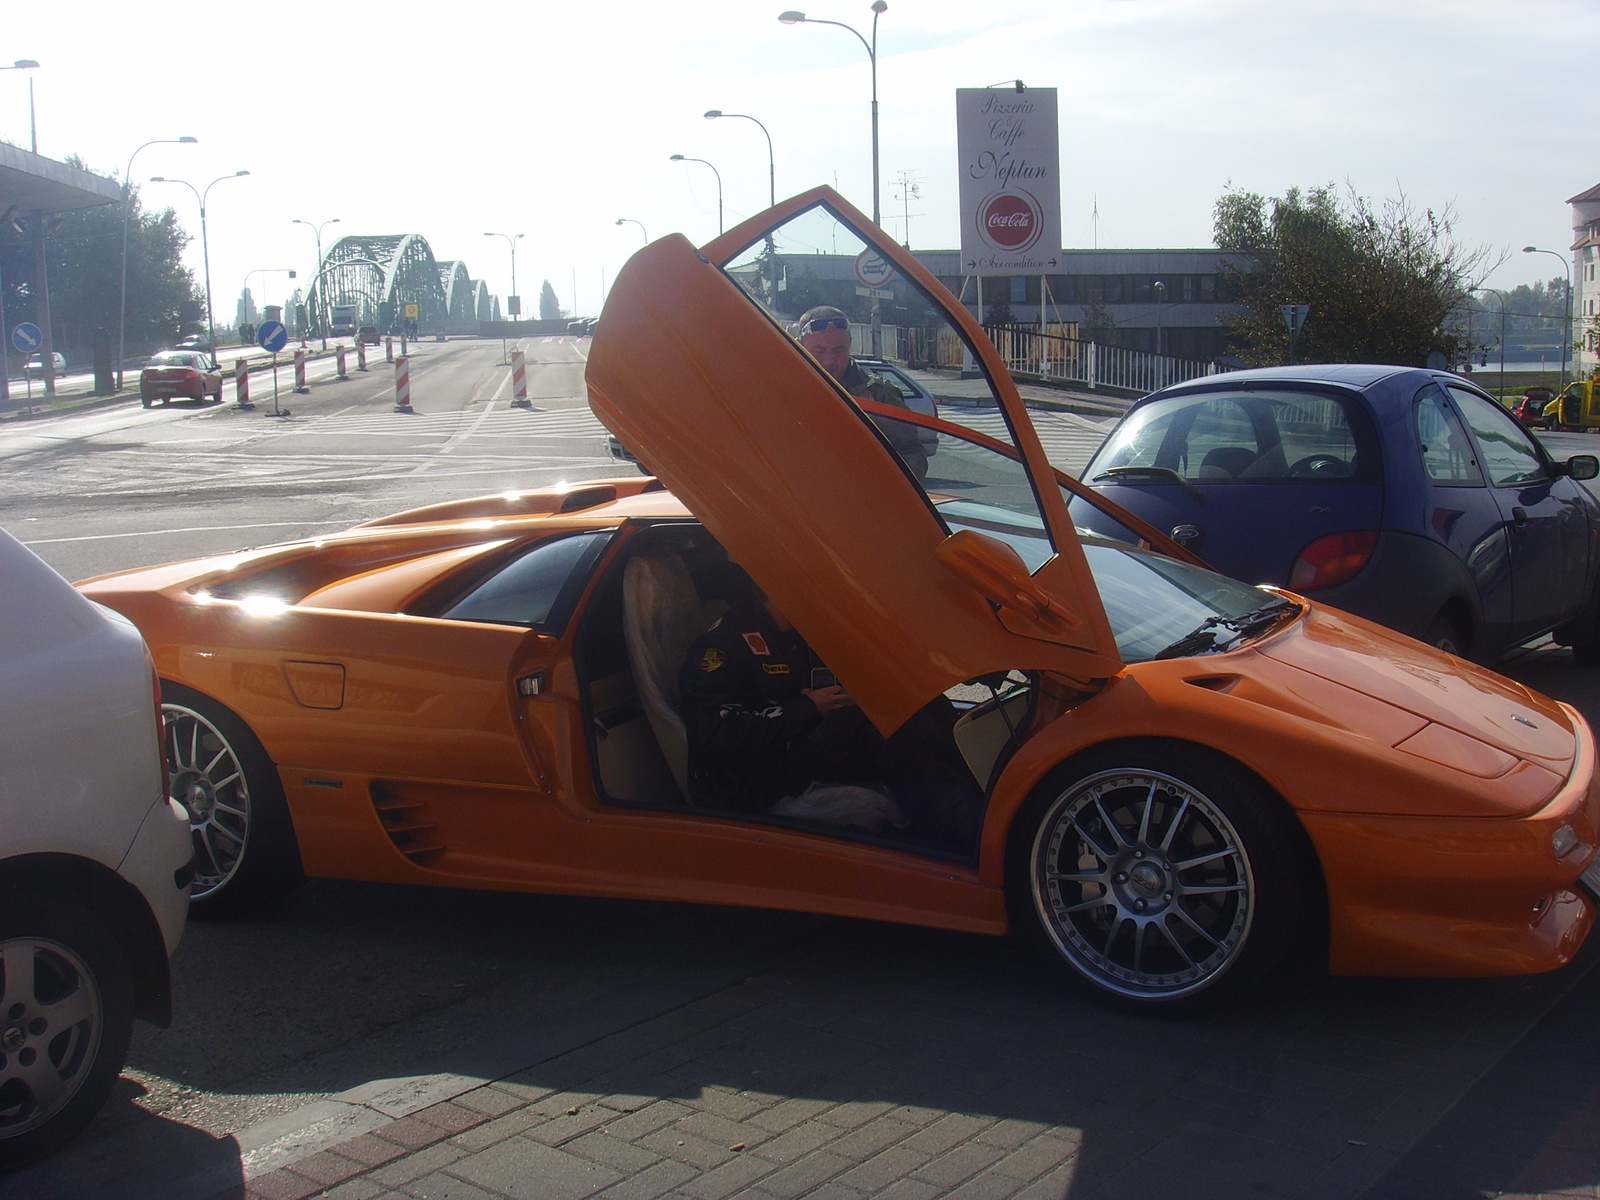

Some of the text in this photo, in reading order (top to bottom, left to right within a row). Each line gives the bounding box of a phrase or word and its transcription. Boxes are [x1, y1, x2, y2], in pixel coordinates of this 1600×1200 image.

[981, 94, 1034, 114] Pizzeria
[988, 119, 1025, 146] Caffe
[970, 151, 1047, 189] Neptun
[988, 212, 1030, 228] Coca-Cola
